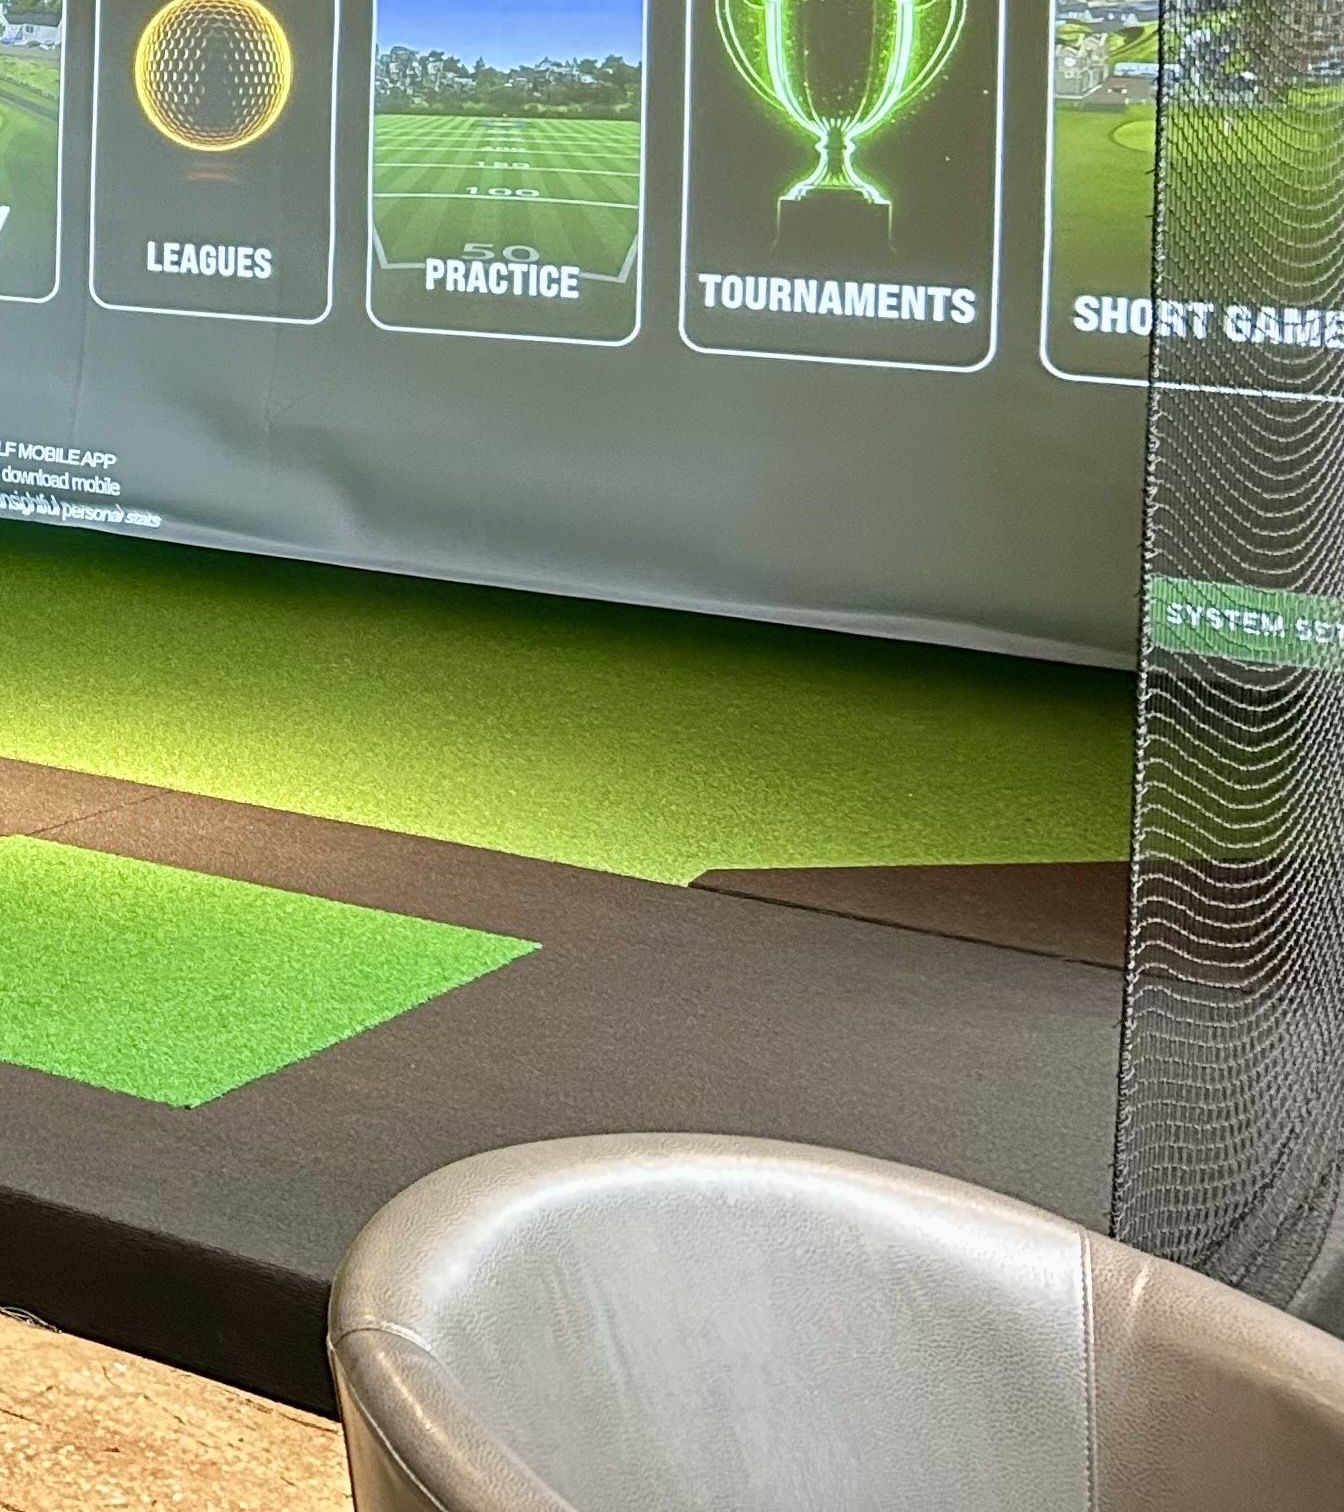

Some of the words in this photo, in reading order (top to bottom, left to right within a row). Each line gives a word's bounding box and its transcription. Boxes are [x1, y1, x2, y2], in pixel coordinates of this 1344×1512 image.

[465, 186, 540, 198] 100
[146, 240, 273, 280] LEAGUES
[461, 242, 540, 263] 50
[425, 257, 580, 299] PRACTICE
[697, 272, 977, 324] TOURNAMENTS
[1072, 294, 1215, 339] SHORT
[1225, 304, 1344, 349] GAME
[18, 443, 81, 466] MOBILE
[80, 452, 117, 470] APP
[2, 465, 69, 489] download
[72, 475, 121, 497] mobile
[61, 499, 125, 524] personal
[124, 509, 162, 529] stats
[1166, 602, 1286, 639] SYSTEM
